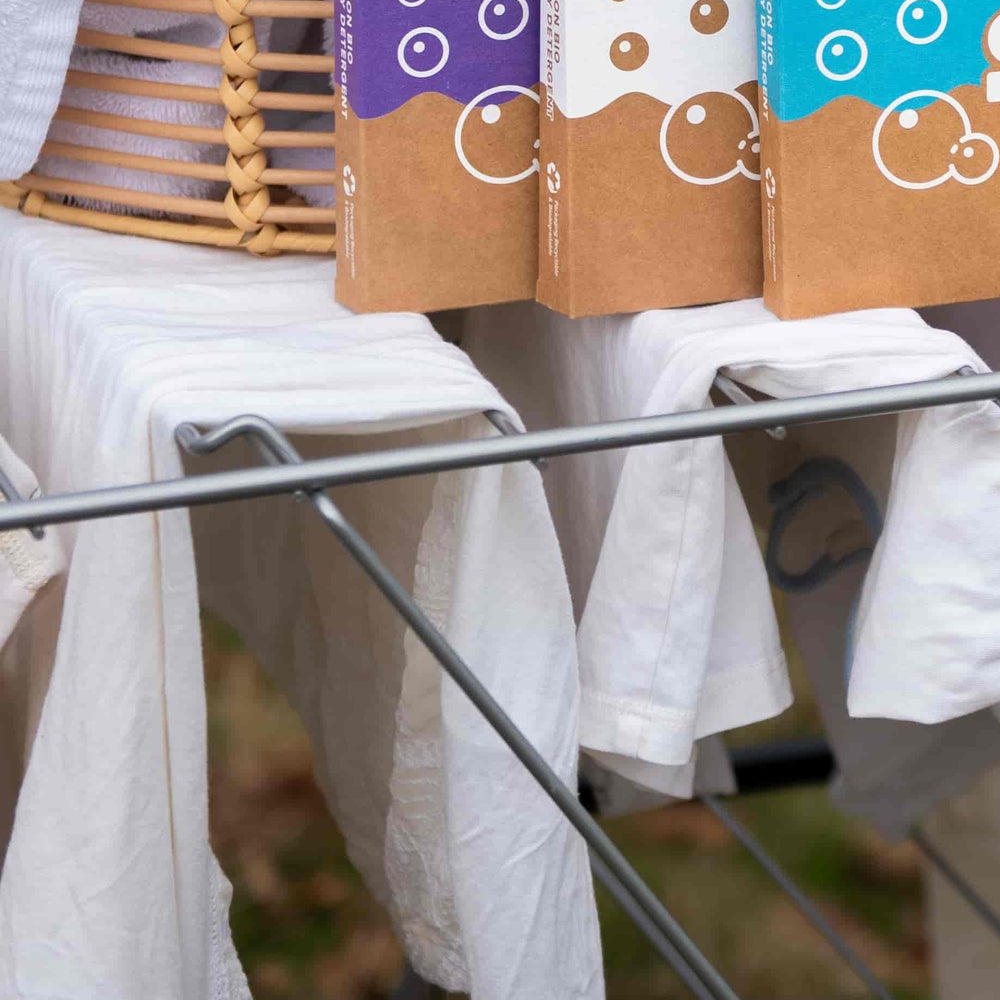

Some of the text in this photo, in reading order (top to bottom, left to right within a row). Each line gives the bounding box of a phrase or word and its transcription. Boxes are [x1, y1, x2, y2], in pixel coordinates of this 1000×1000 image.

[339, 13, 348, 121] DETERGENT
[546, 12, 554, 122] DETERGENT
[760, 15, 769, 121] DETERGENT
